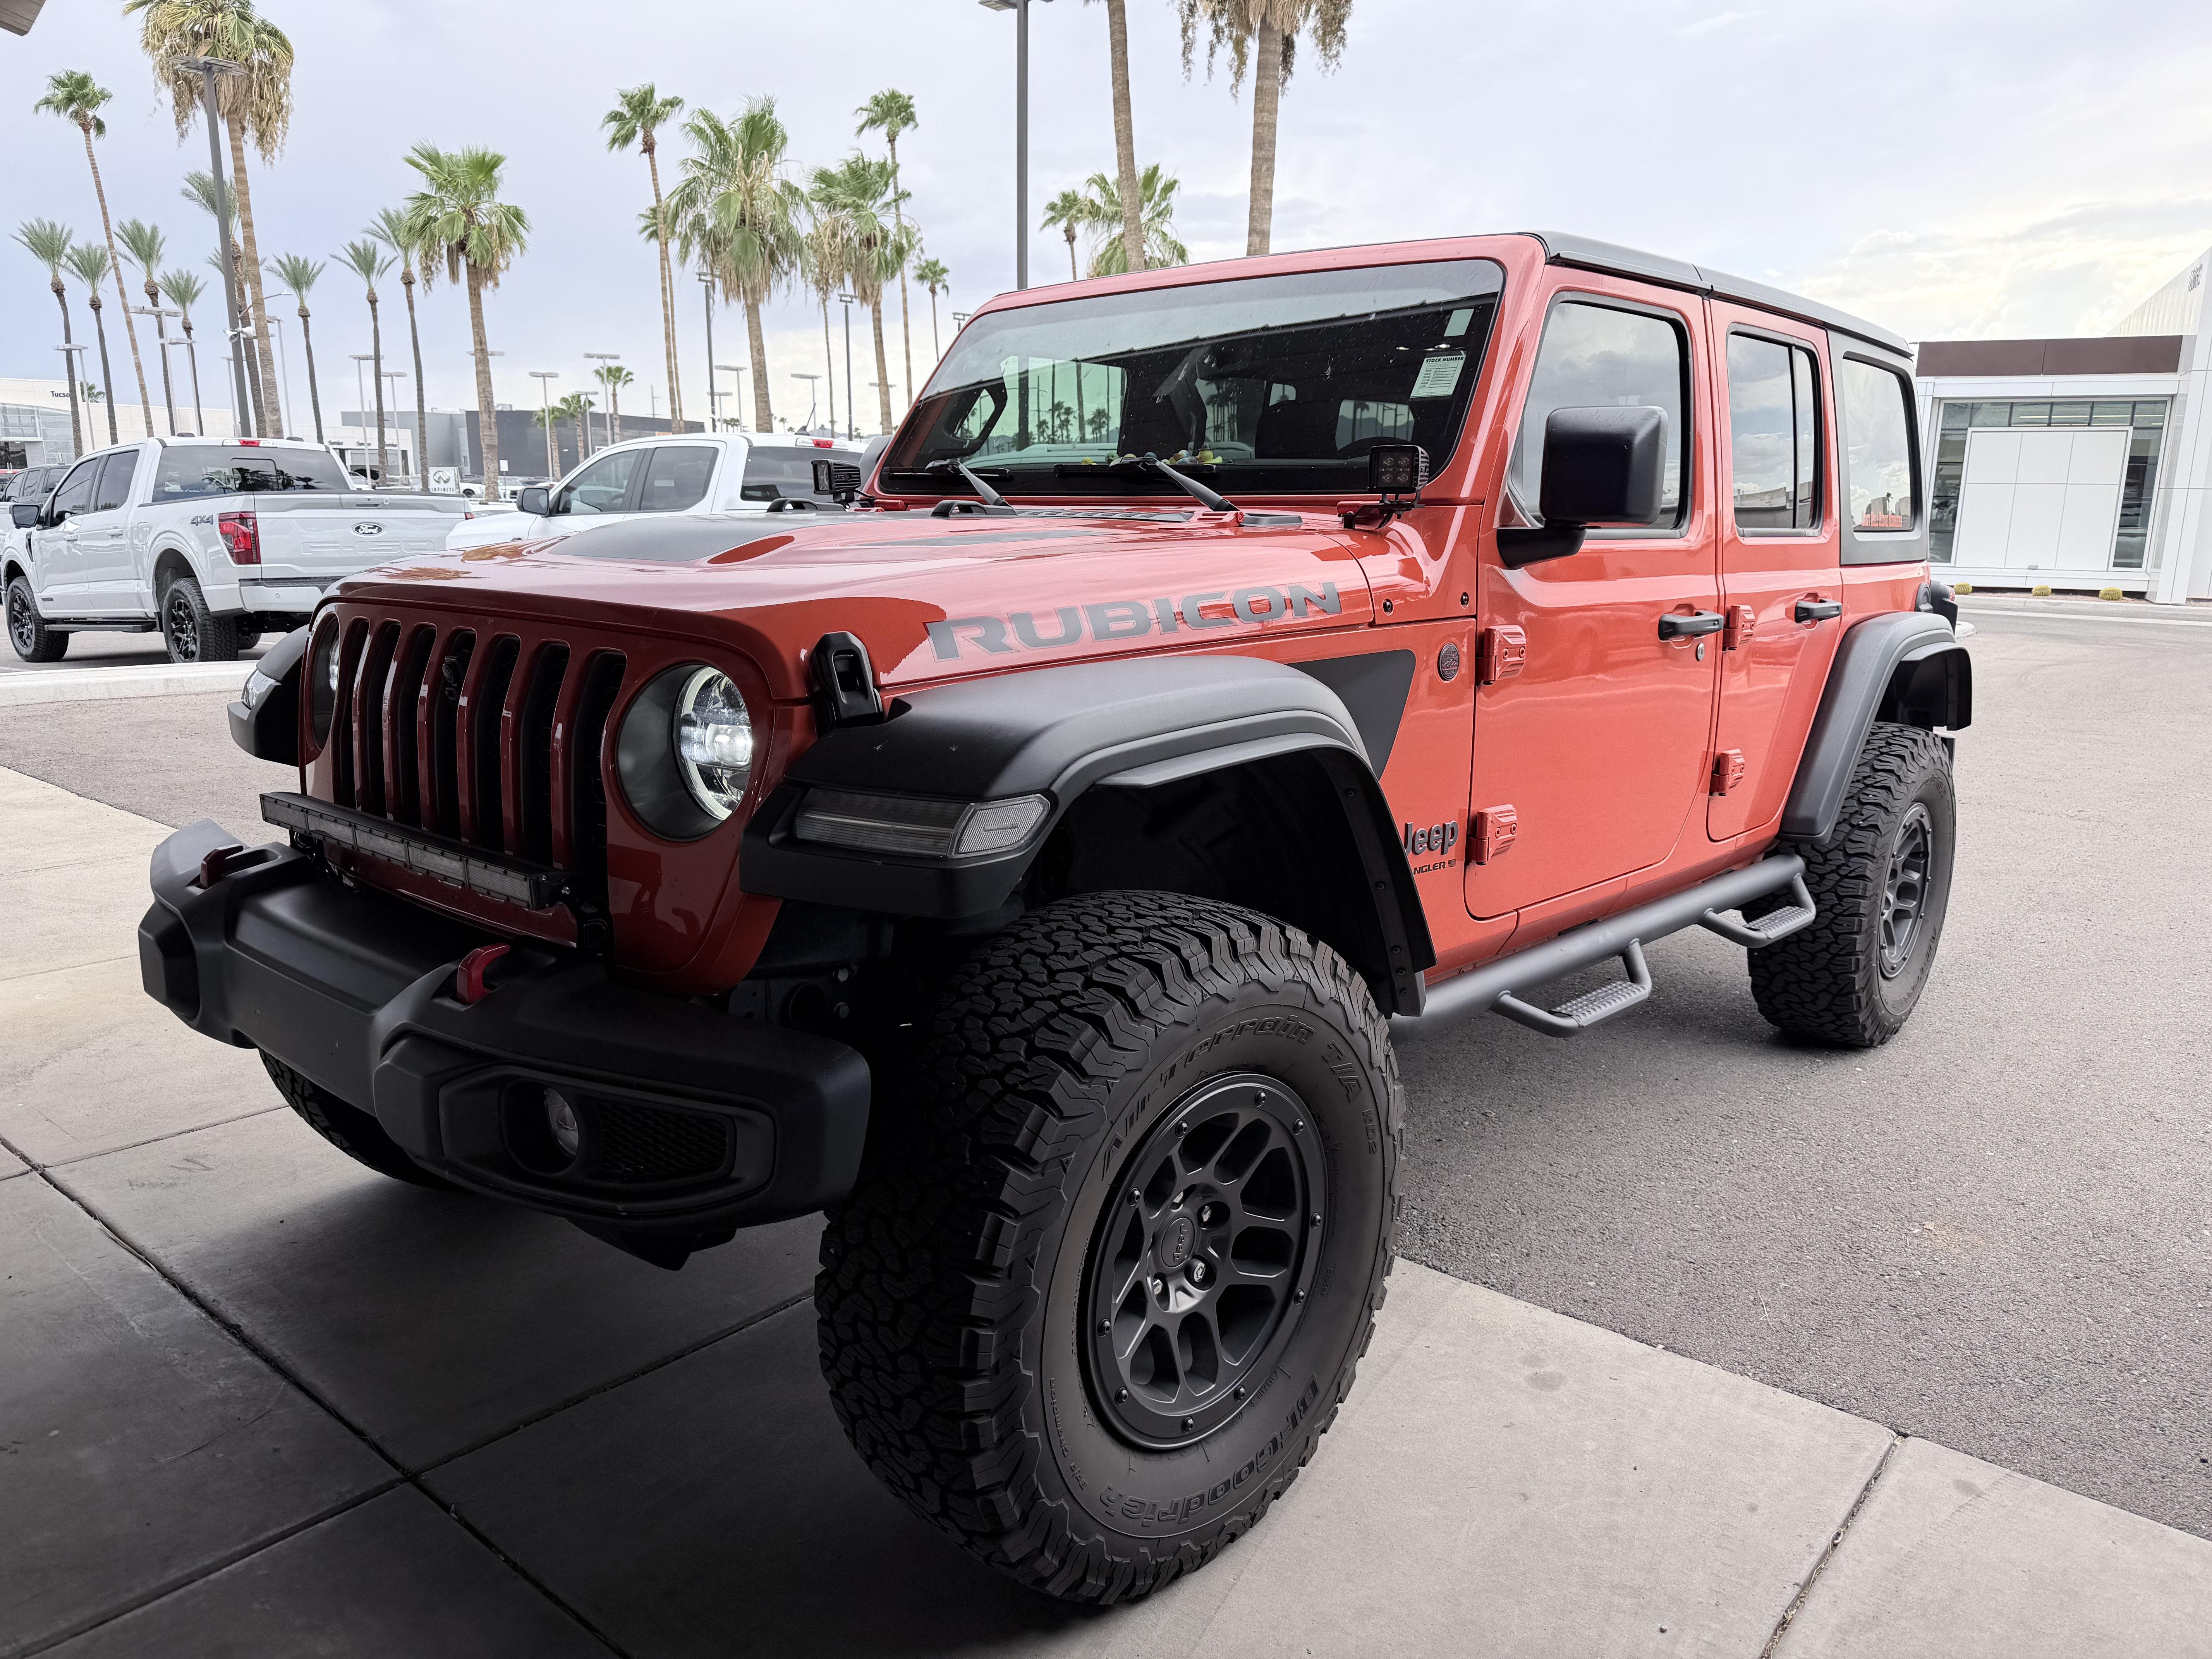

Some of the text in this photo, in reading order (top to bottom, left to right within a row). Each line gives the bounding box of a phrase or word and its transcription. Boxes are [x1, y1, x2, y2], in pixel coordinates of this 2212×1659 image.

[359, 524, 379, 534] Ford
[924, 581, 1342, 662] RUBICON
[1404, 820, 1459, 855] Jeep
[1413, 861, 1446, 875] NGLER
[1173, 1223, 1188, 1262] Jeep
[1100, 1374, 1320, 1527] BFGoodrich
